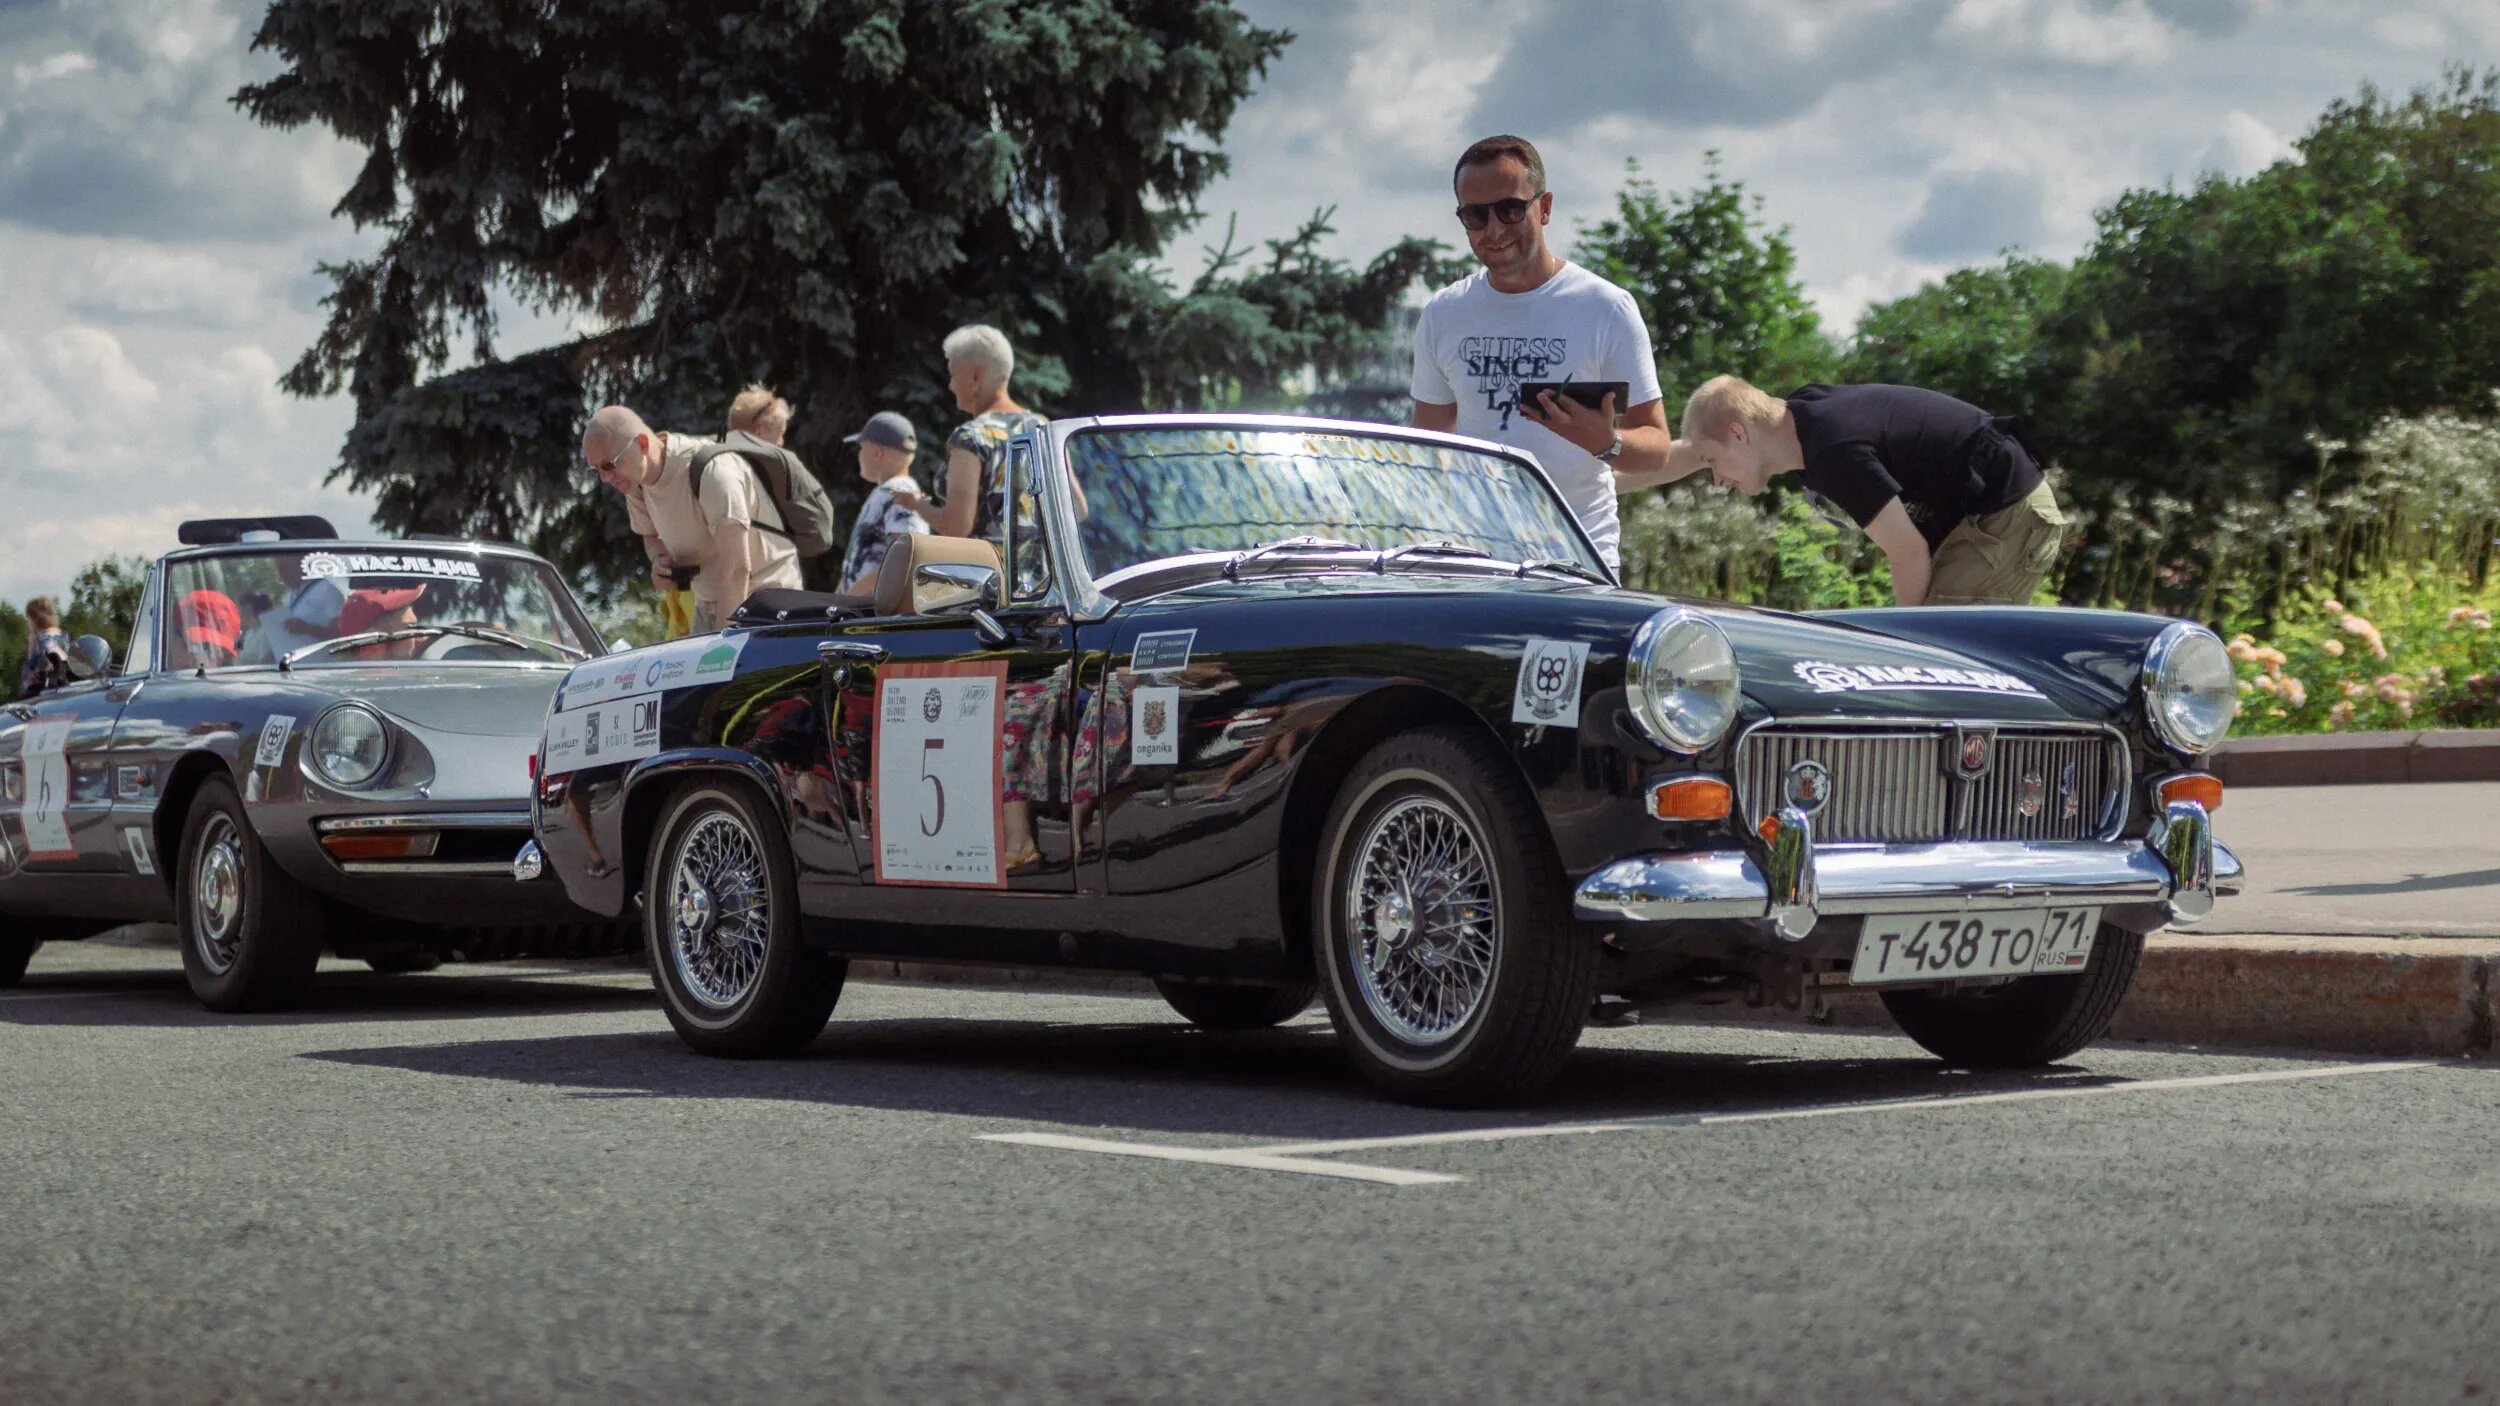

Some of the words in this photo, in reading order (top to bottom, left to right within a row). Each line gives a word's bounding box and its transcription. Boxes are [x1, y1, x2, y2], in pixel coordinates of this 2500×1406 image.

[1458, 336, 1567, 365] GUESS
[1467, 355, 1550, 378] SINCE
[351, 556, 480, 577] НАСЛЕДИЕ
[633, 700, 658, 733] DM
[1966, 739, 1985, 765] MG
[36, 757, 50, 823] 6
[921, 739, 945, 837] 5
[2047, 911, 2088, 950] 71
[2037, 951, 2065, 966] RUS
